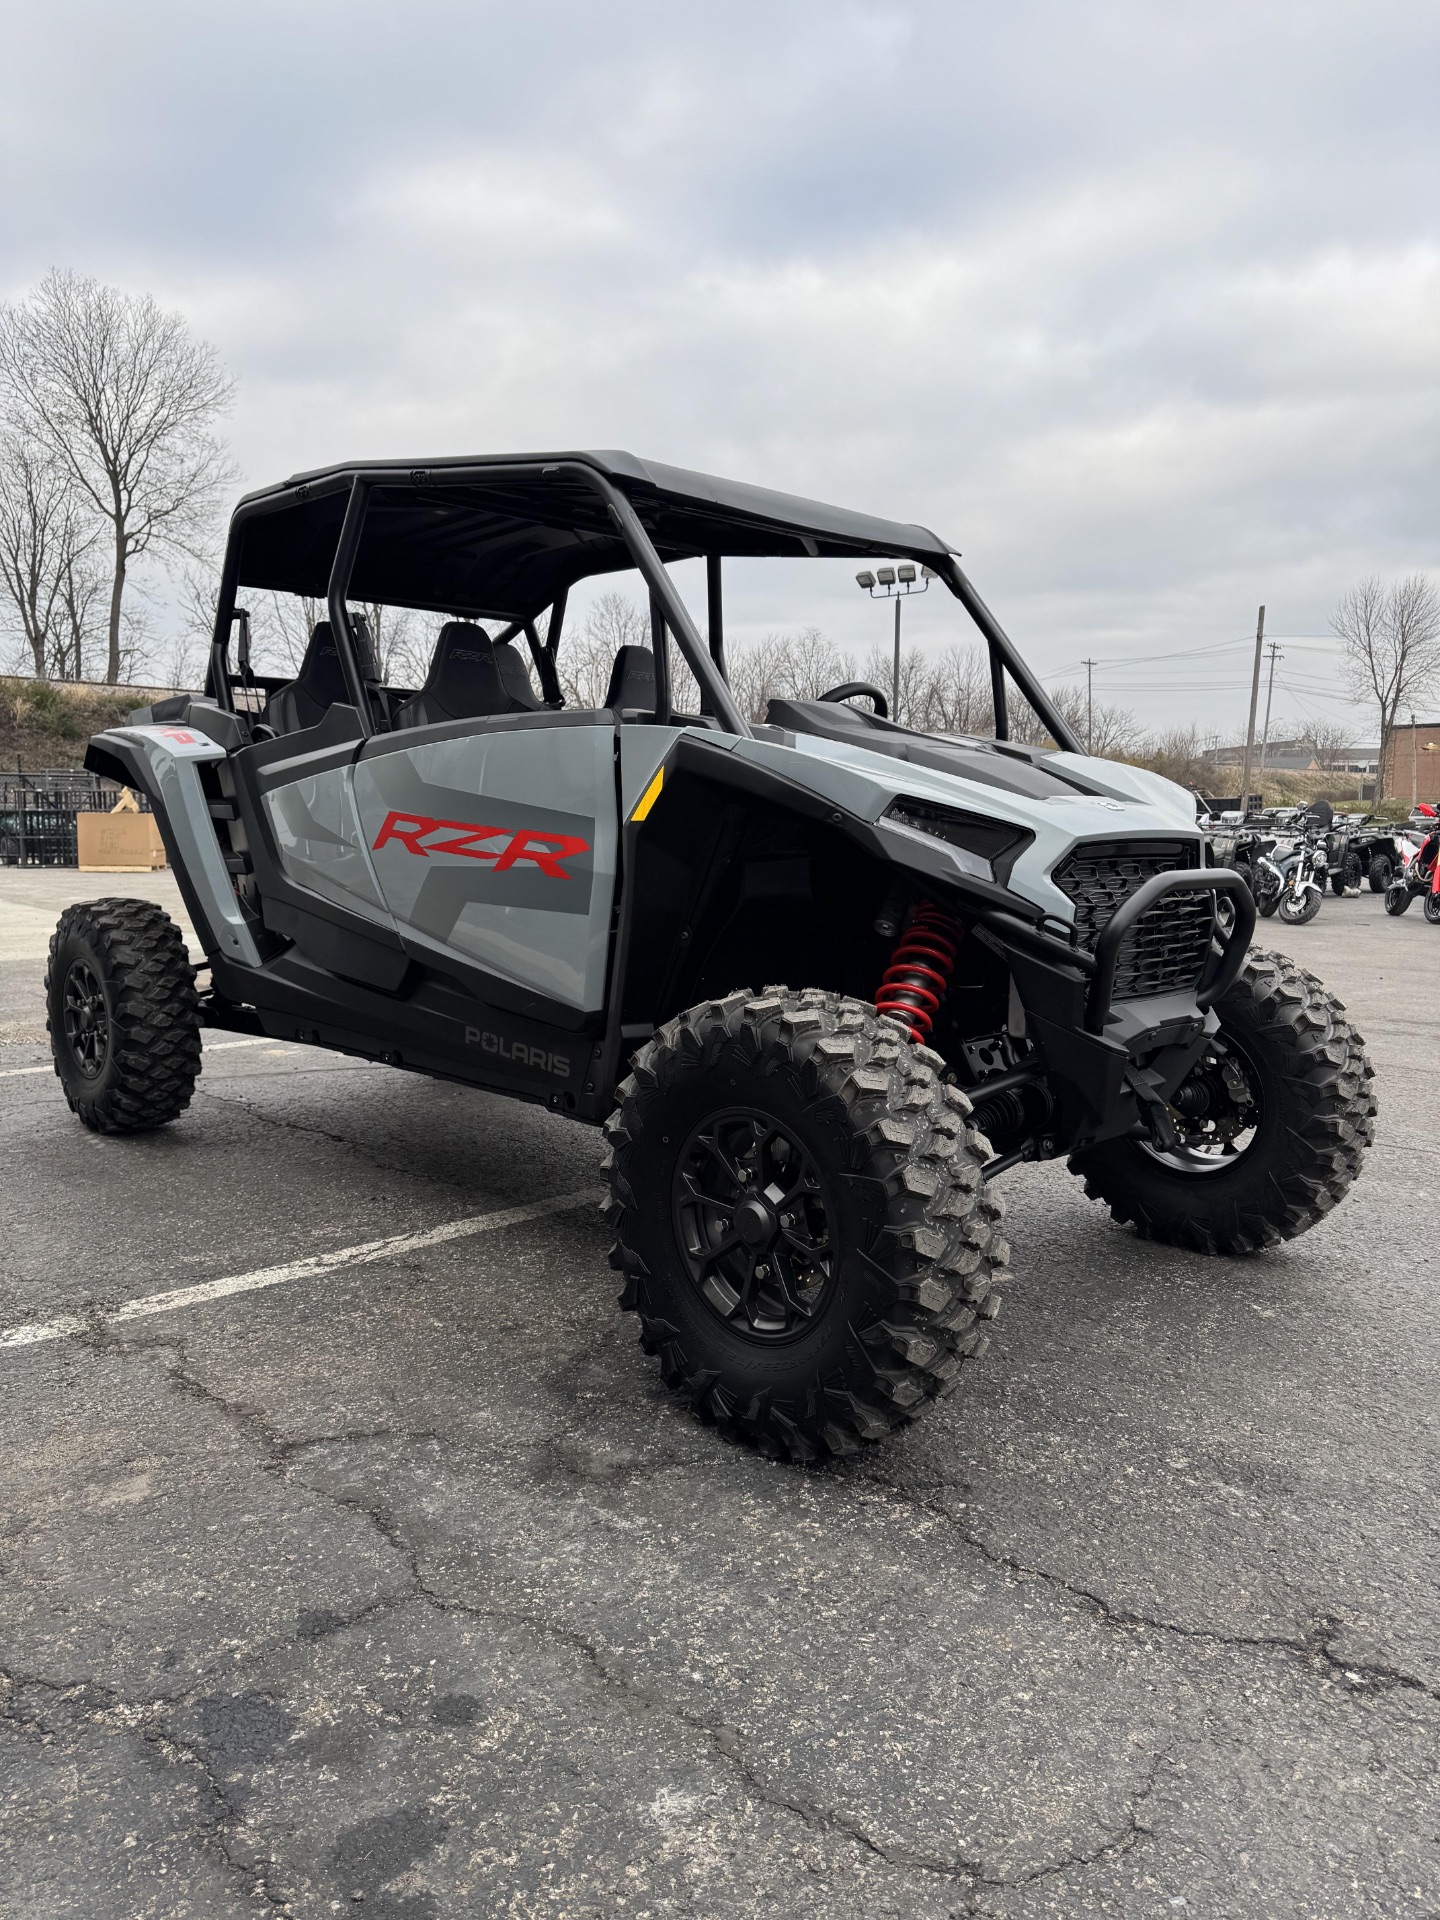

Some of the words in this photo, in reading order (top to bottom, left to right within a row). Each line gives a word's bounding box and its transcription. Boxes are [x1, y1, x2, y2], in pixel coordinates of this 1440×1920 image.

[449, 648, 493, 664] RZR
[372, 811, 590, 880] RZR
[464, 1025, 570, 1077] POLARIS
